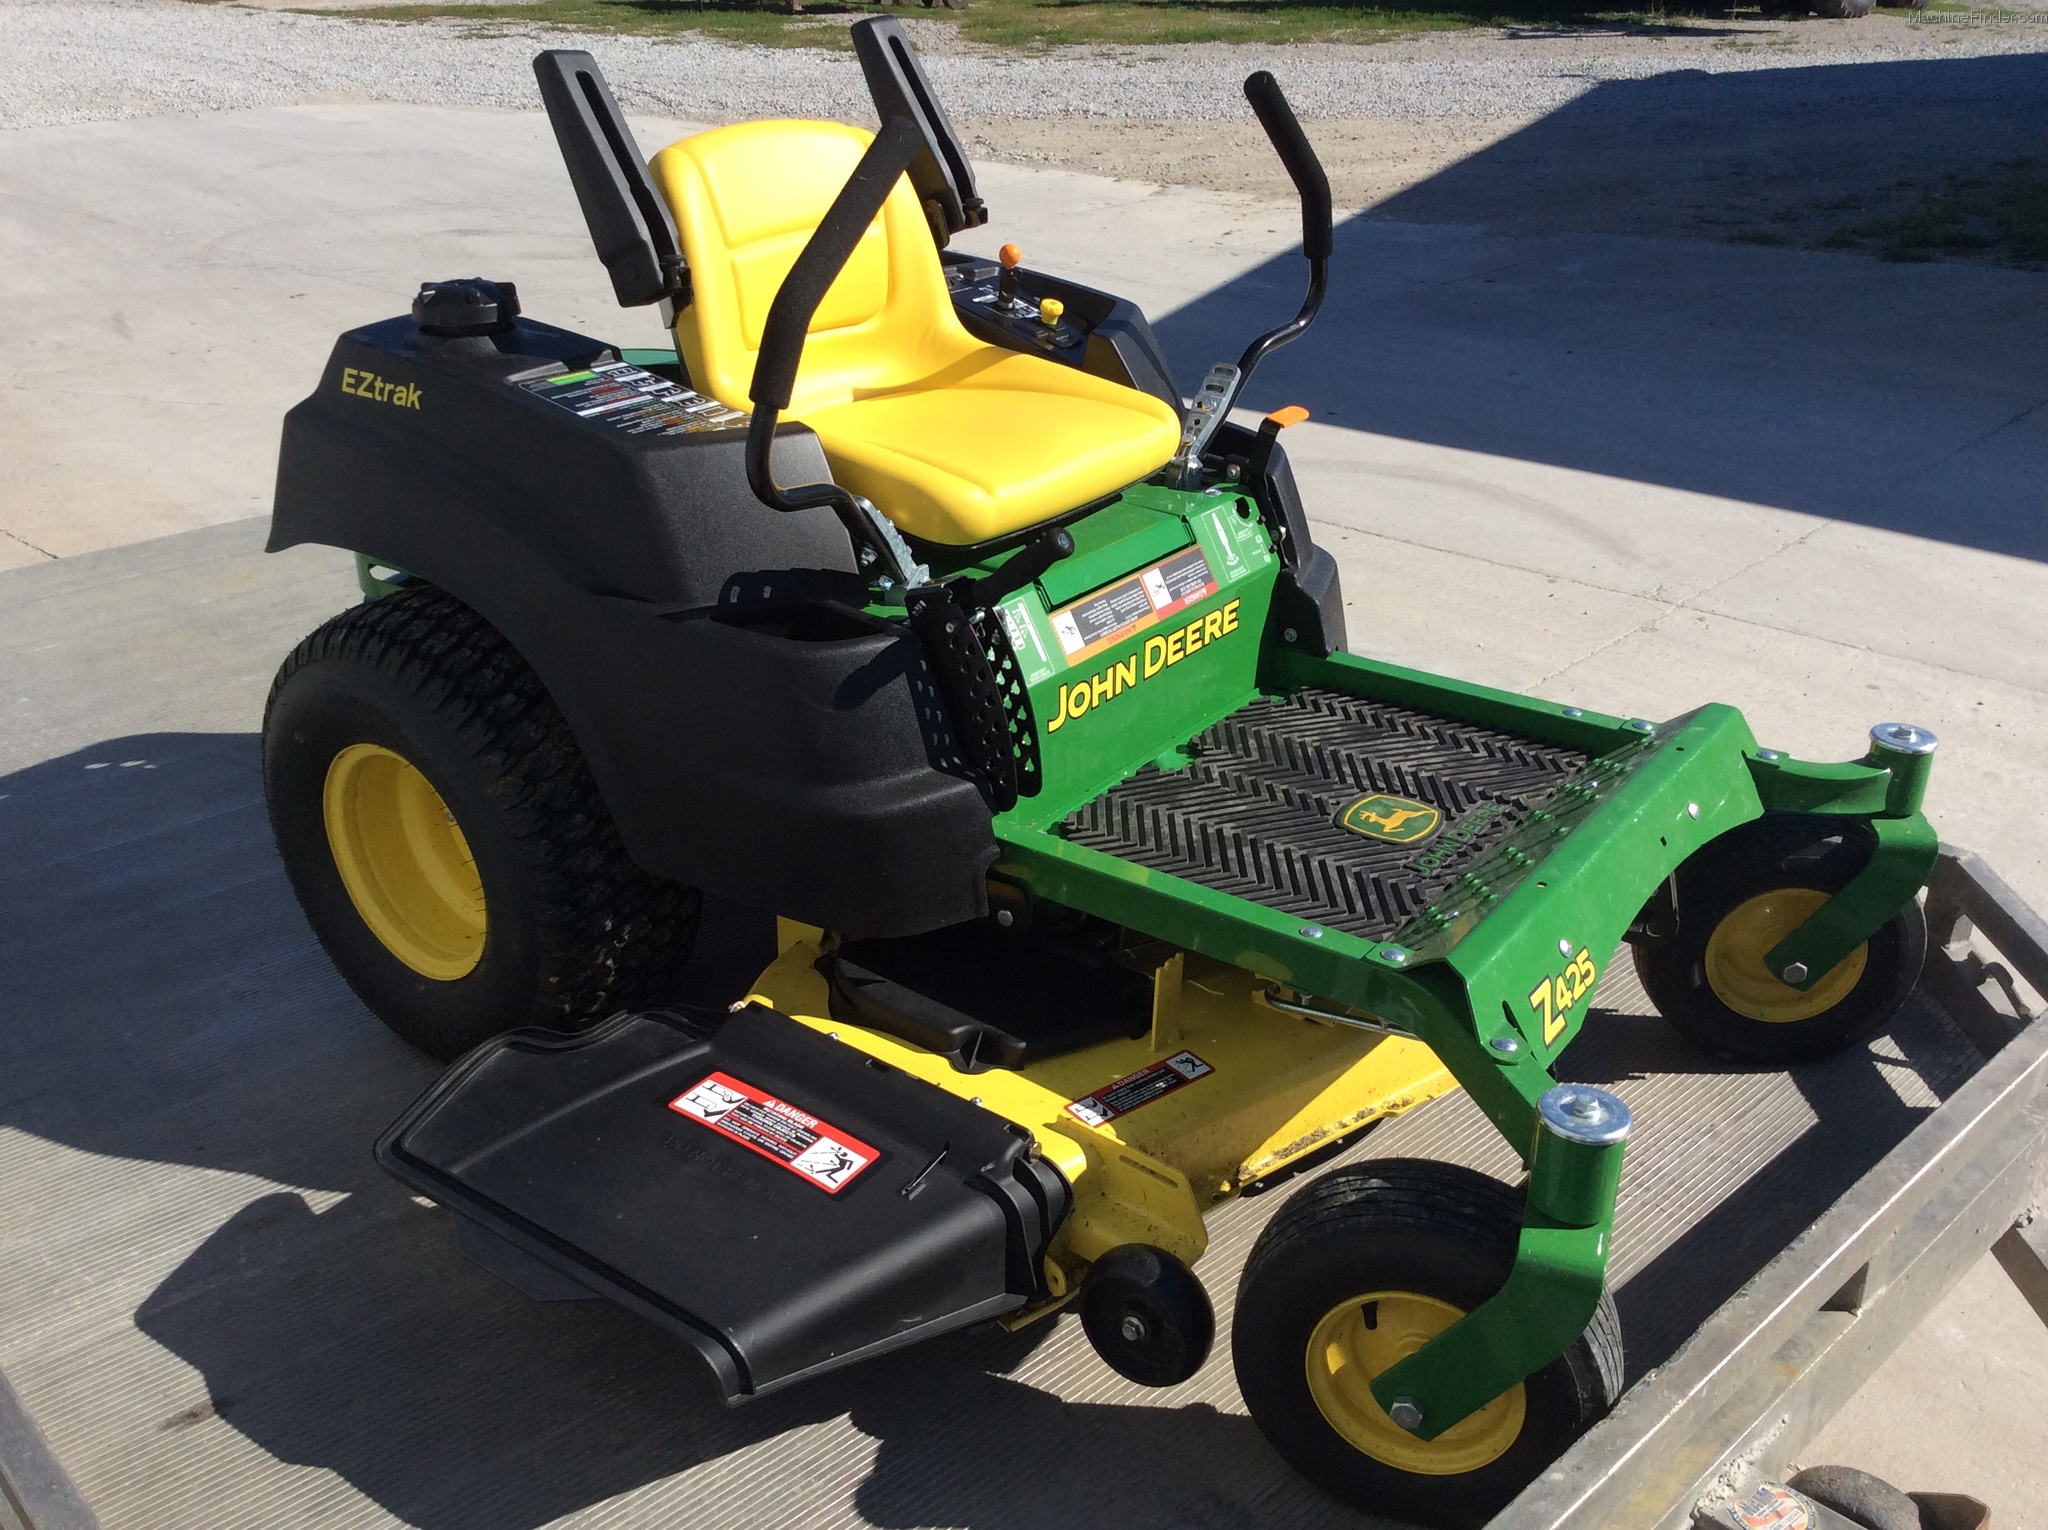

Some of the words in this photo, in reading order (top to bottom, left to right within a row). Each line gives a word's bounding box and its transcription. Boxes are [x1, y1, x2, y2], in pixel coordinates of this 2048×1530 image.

[341, 367, 423, 411] EZtrak
[1047, 653, 1138, 734] JOHN
[1143, 597, 1241, 681] DEERE
[1409, 839, 1462, 877] JOHN
[1449, 802, 1507, 842] DEERE
[1527, 945, 1597, 1052] Z425
[1118, 1069, 1151, 1087] DANGER
[773, 1103, 819, 1129] DANGER
